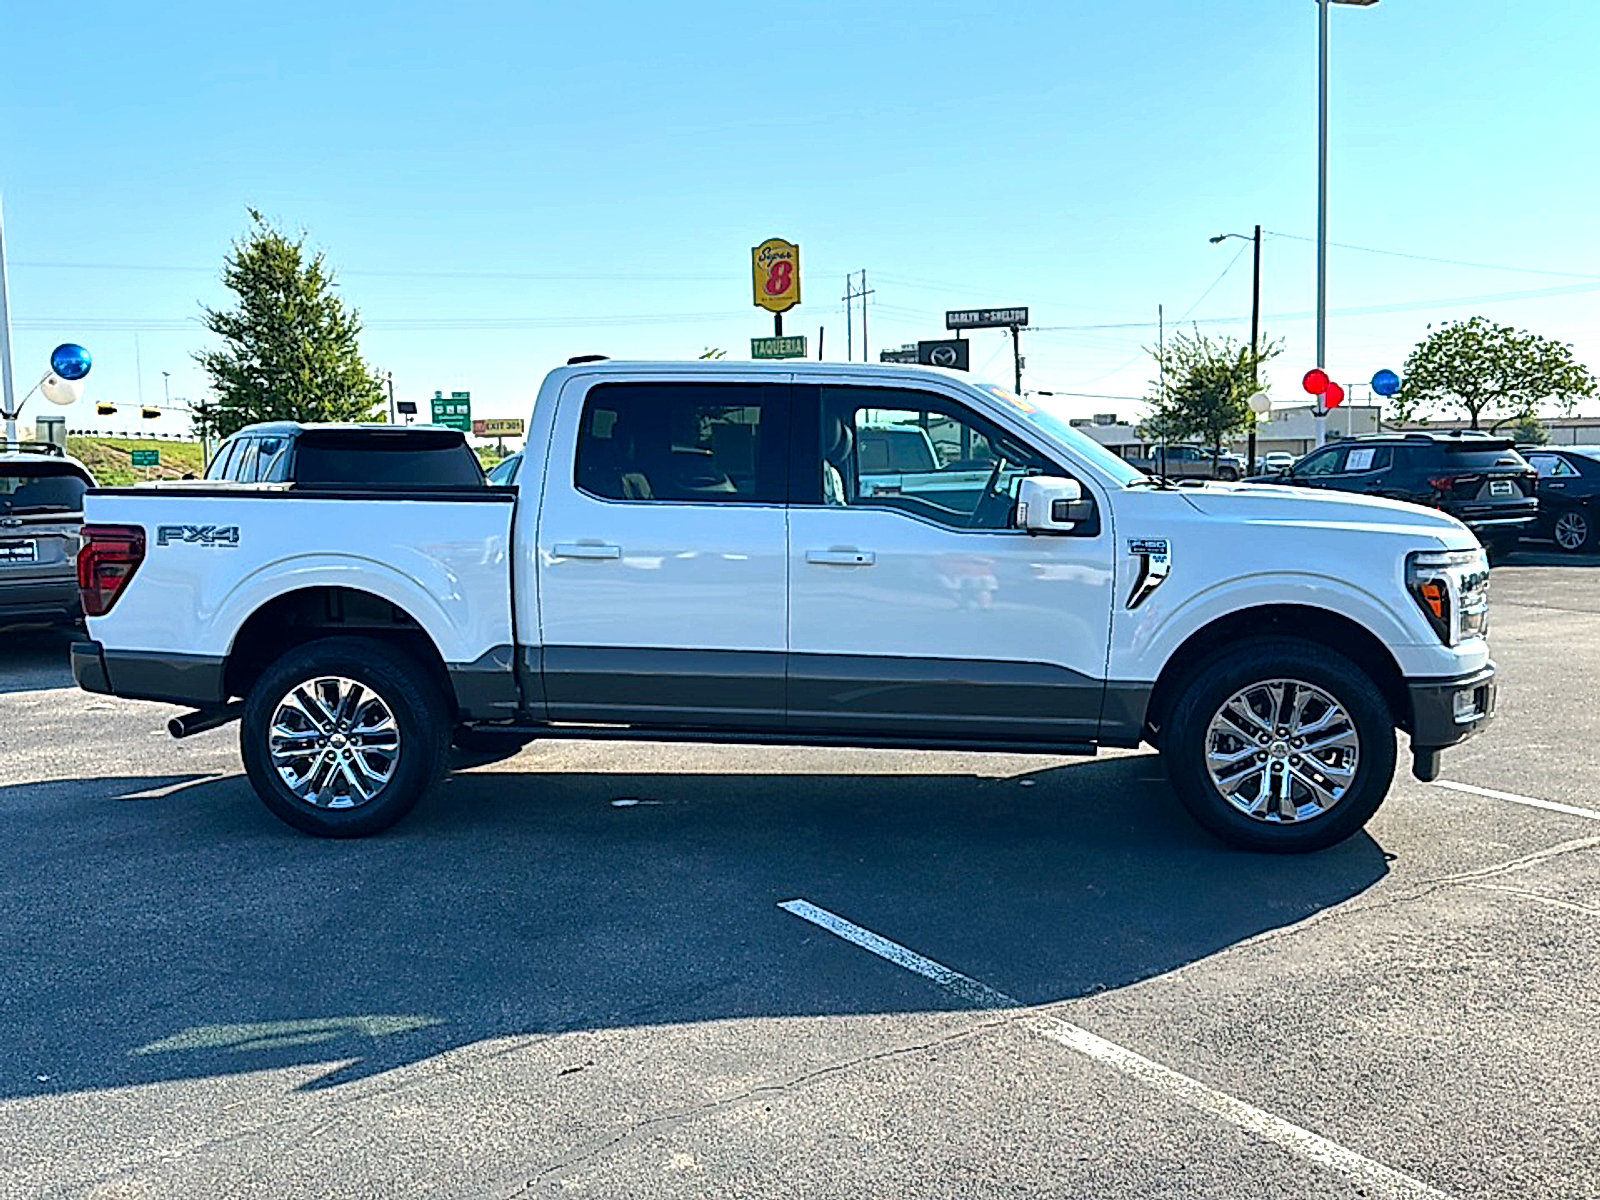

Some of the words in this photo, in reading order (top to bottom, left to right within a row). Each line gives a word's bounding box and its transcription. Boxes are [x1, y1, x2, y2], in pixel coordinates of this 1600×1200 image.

[758, 247, 793, 268] Super
[764, 260, 793, 295] 8
[753, 339, 803, 355] TAQUERIA
[156, 525, 239, 546] FX4
